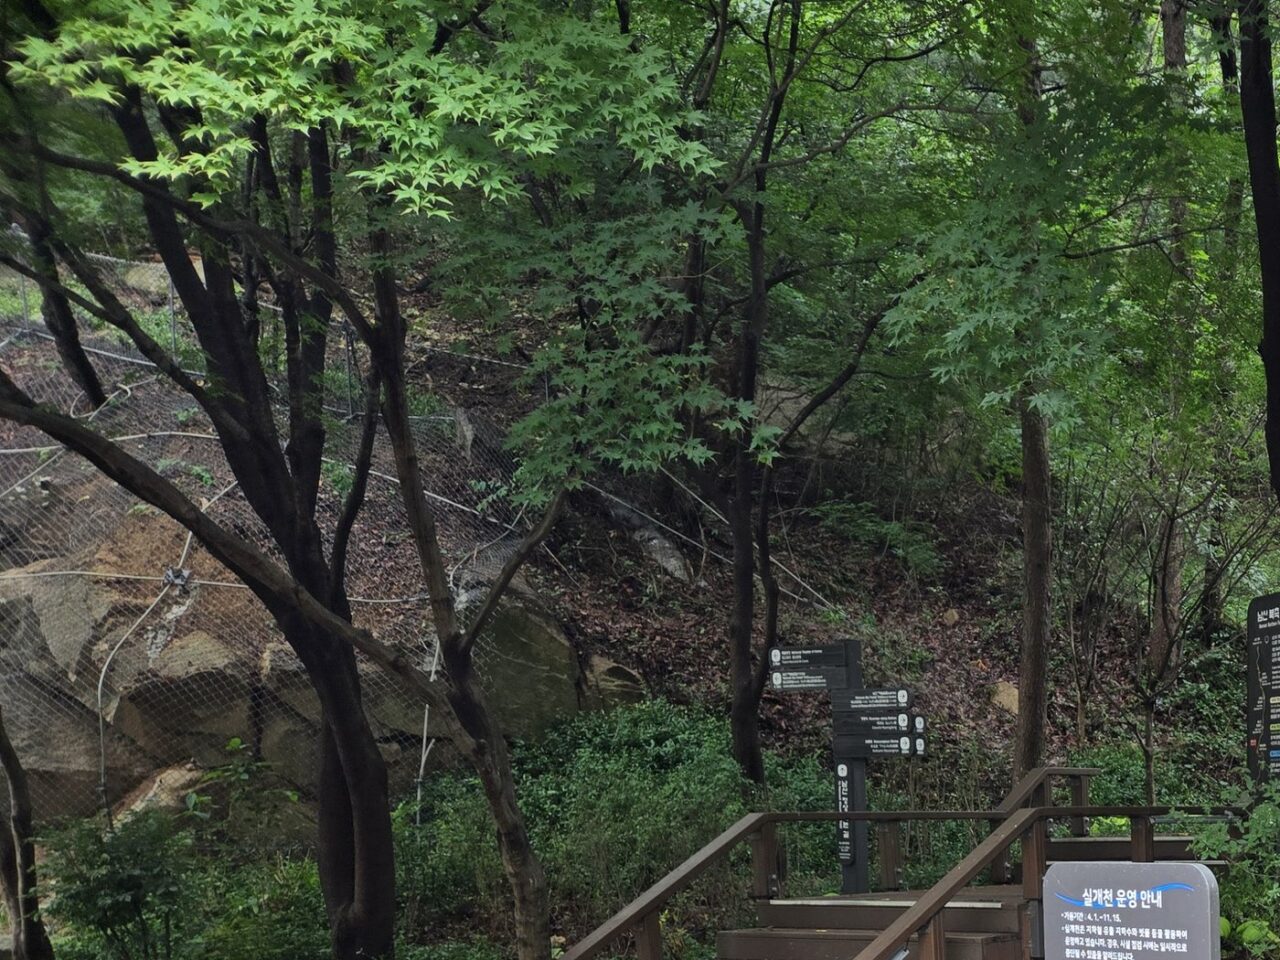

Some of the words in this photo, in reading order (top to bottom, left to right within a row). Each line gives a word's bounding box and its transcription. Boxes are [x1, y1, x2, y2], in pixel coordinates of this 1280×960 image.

[1082, 888, 1113, 907] 실개천
[1115, 889, 1137, 909] 운영
[1140, 890, 1162, 909] 안내
